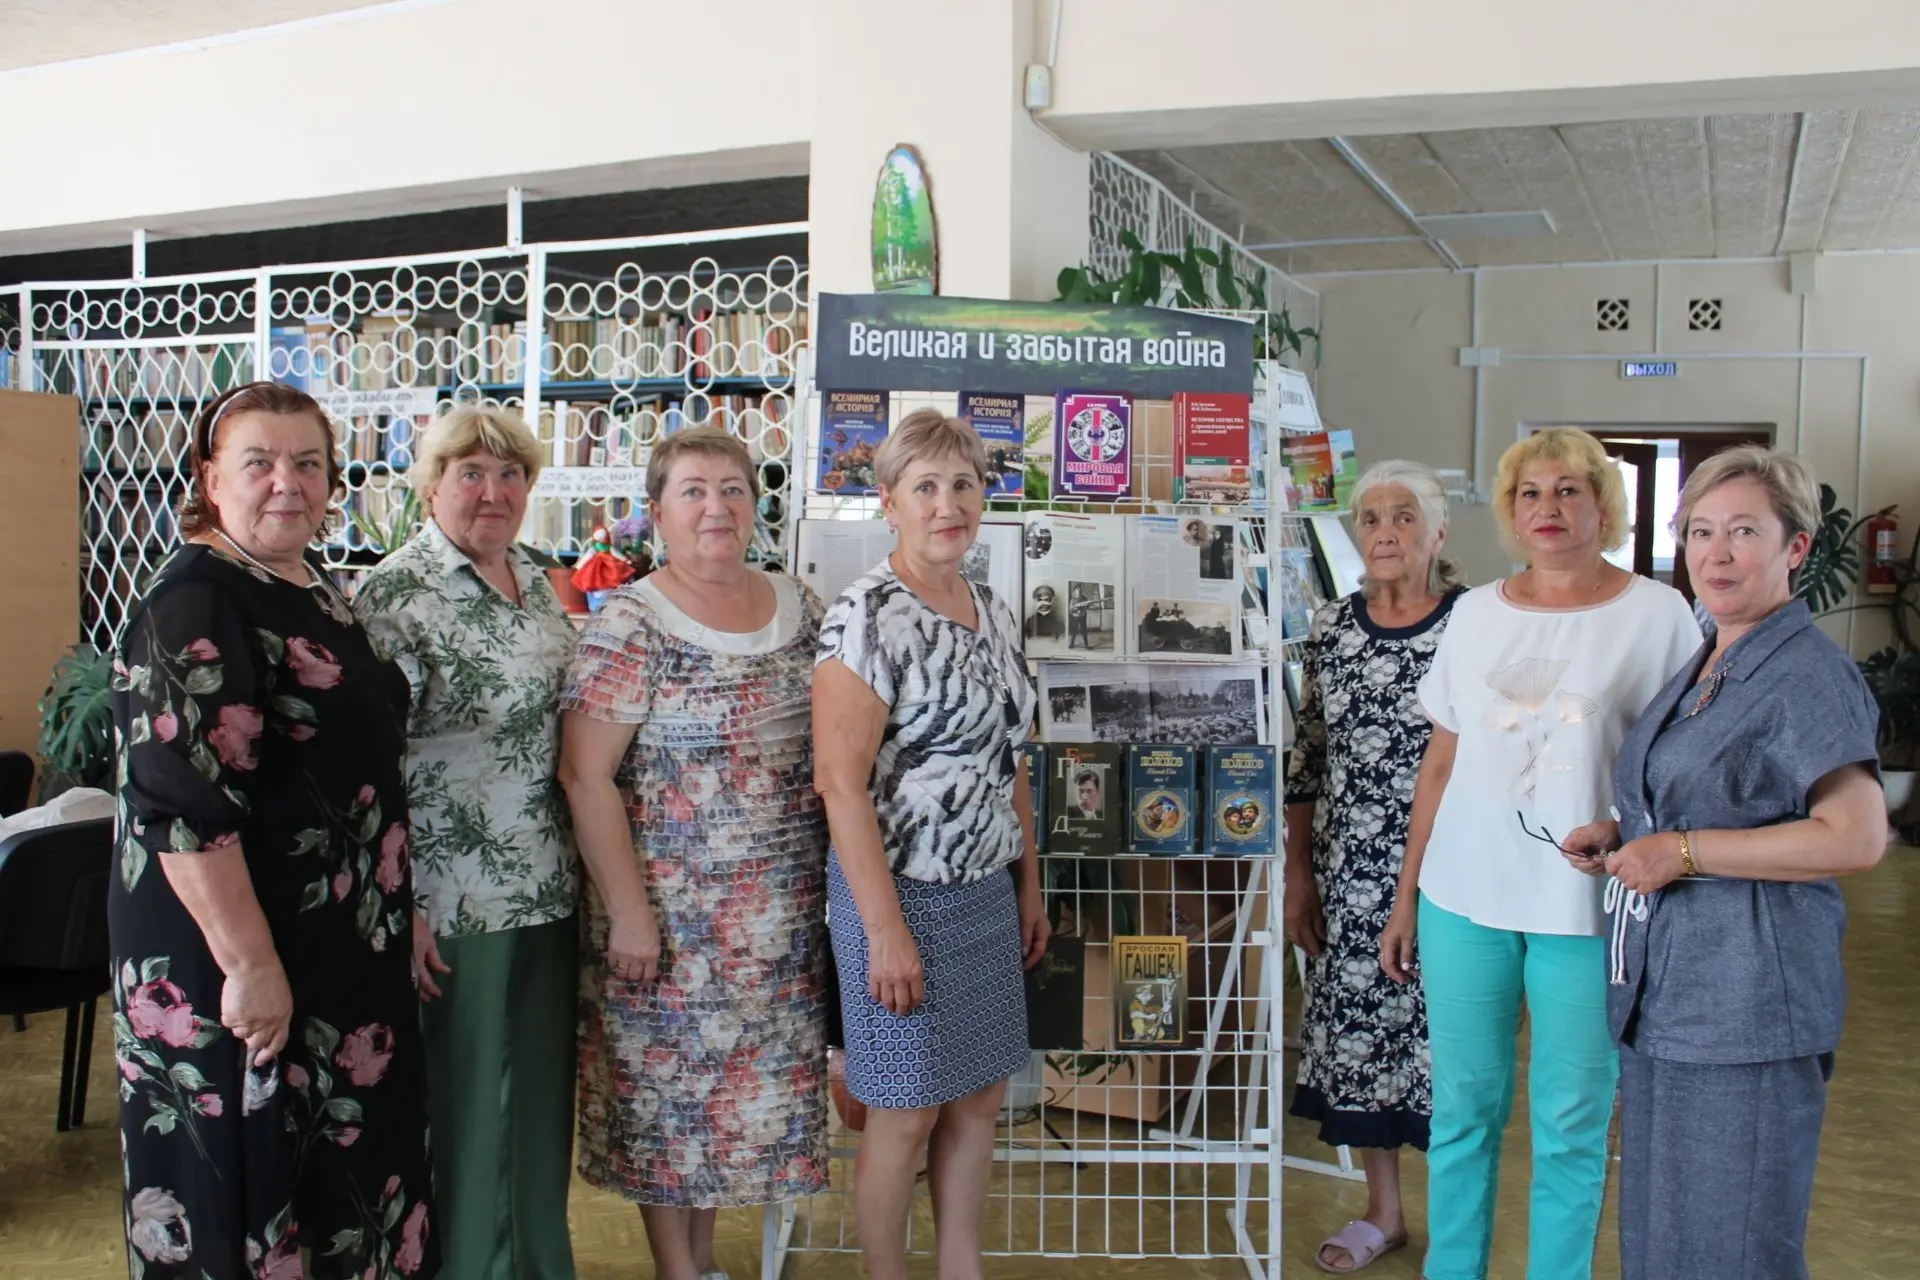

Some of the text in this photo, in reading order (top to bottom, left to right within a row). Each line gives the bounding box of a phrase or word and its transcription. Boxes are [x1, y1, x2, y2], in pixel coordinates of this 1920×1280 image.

[849, 321, 1226, 368] Великая и забытая война
[1626, 363, 1675, 377] ВЫХОД
[830, 392, 881, 404] ВСЕМИРНАЯ
[968, 396, 1018, 409] ВСЕМИРНАЯ
[835, 402, 875, 412] ИСТОРИЯ
[973, 407, 1012, 417] ИСТОРИЯ
[1066, 461, 1124, 474] МИРОВАЯ
[1074, 472, 1115, 486] ВОЙНА
[1140, 756, 1184, 767] ШОЛОХОВ
[1221, 758, 1265, 769] ШОЛОХОВ
[1125, 945, 1176, 953] ЯРОСЛАВ
[1125, 952, 1177, 979] ГАШЕК
